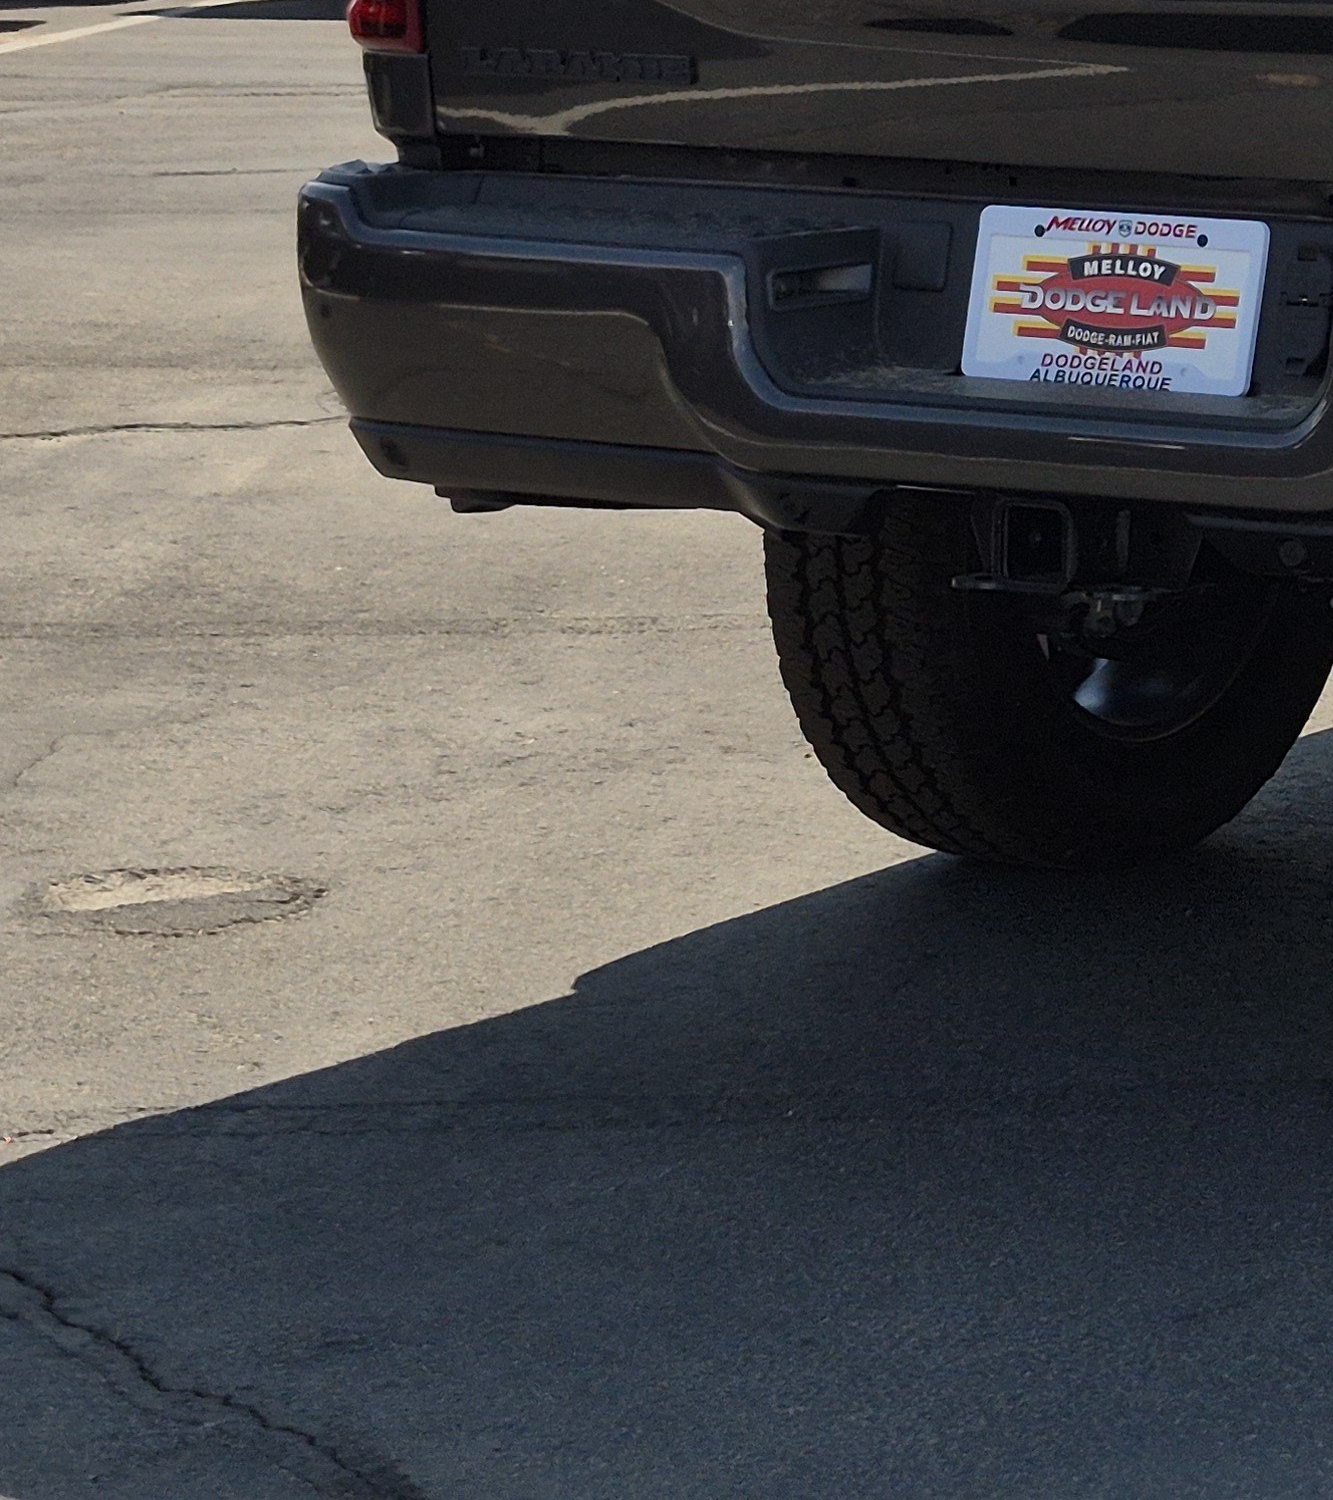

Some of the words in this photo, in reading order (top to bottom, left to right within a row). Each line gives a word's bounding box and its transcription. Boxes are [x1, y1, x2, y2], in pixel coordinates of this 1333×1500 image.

[1045, 215, 1118, 237] MELLOY
[1134, 221, 1198, 239] DODGE
[1083, 258, 1166, 281] MELLOY
[1040, 352, 1163, 376] DODGELAND
[1029, 368, 1172, 390] ALBUQUERQUE
